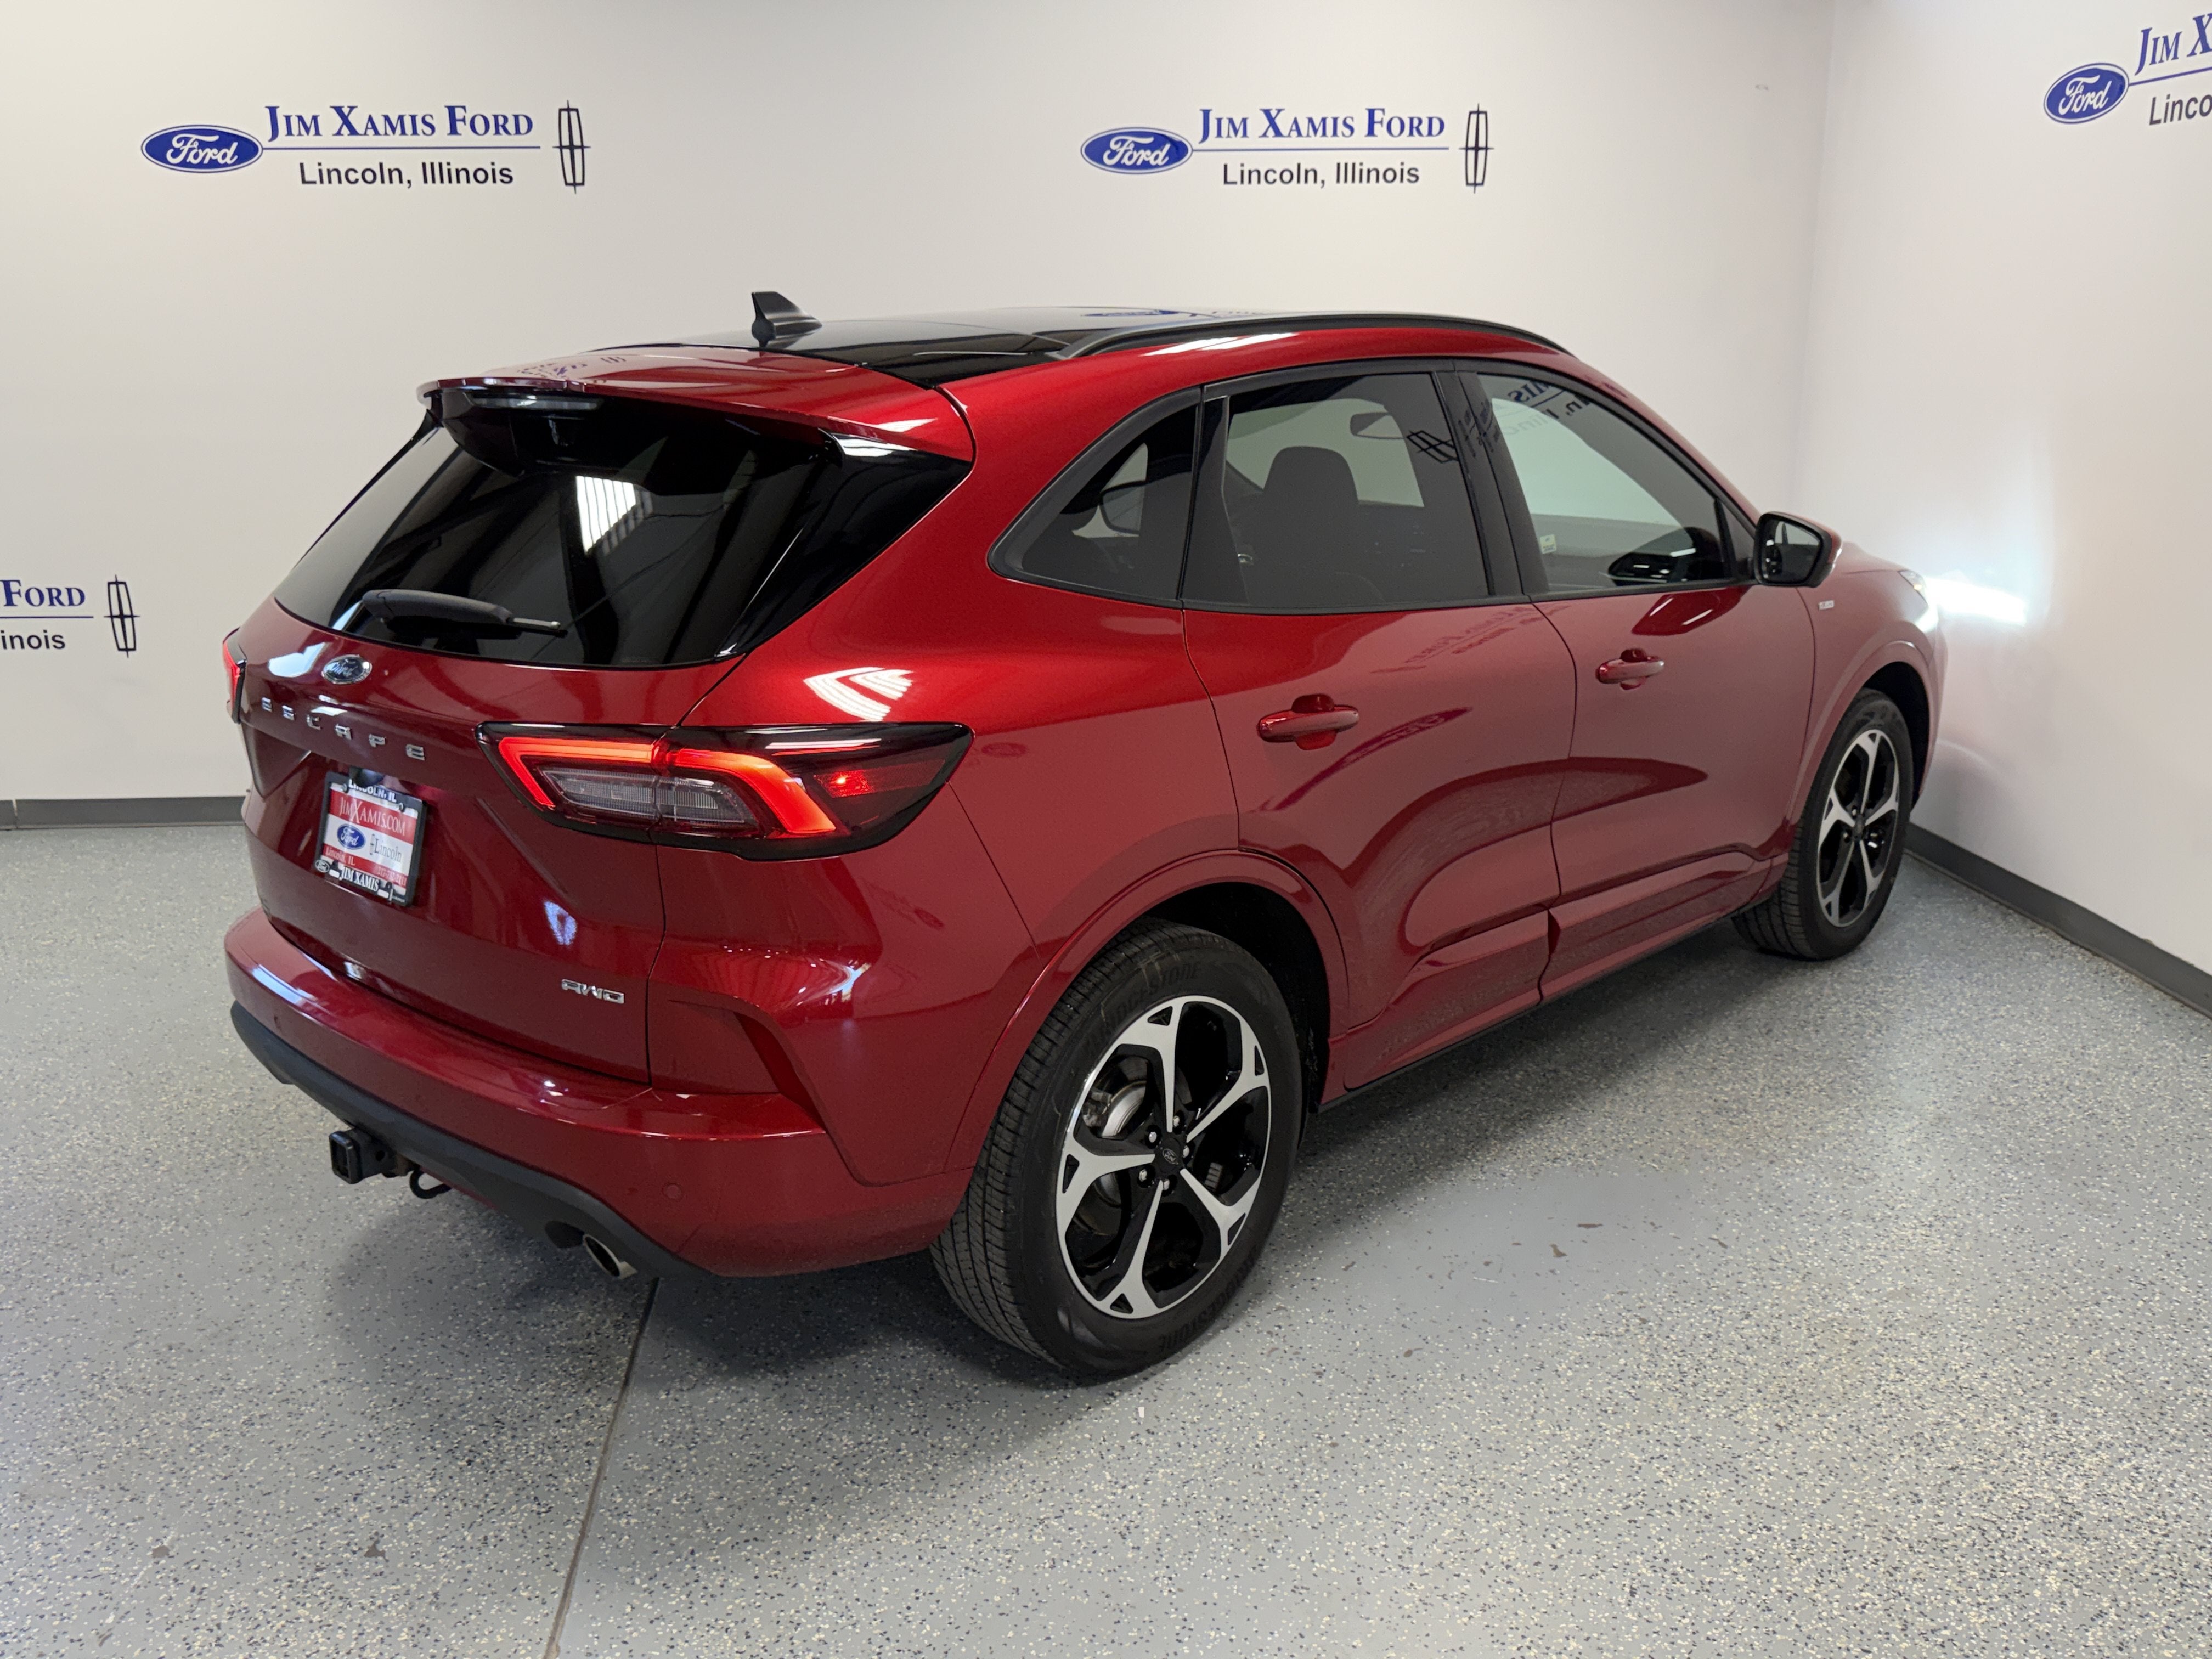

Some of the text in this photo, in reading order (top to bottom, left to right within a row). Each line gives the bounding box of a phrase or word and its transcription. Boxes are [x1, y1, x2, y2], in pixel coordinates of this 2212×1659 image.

[2135, 27, 2182, 75] JIM
[2058, 75, 2112, 115] Ford
[265, 105, 533, 142] JIM XAMIS FORD
[1199, 108, 1445, 144] JIM XAMIS FORD
[166, 133, 238, 165] Ford
[1102, 134, 1169, 166] Ford
[300, 162, 513, 188] Lincoln, Illinois
[1223, 162, 1420, 188] Lincoln, Illinois
[0, 580, 86, 607] FORD
[261, 697, 426, 761] ESCAPE
[340, 826, 359, 846] Ford
[374, 838, 402, 862] Lincoln
[339, 866, 354, 881] JIM
[354, 871, 380, 892] XAMIS
[561, 979, 625, 1004] AWD
